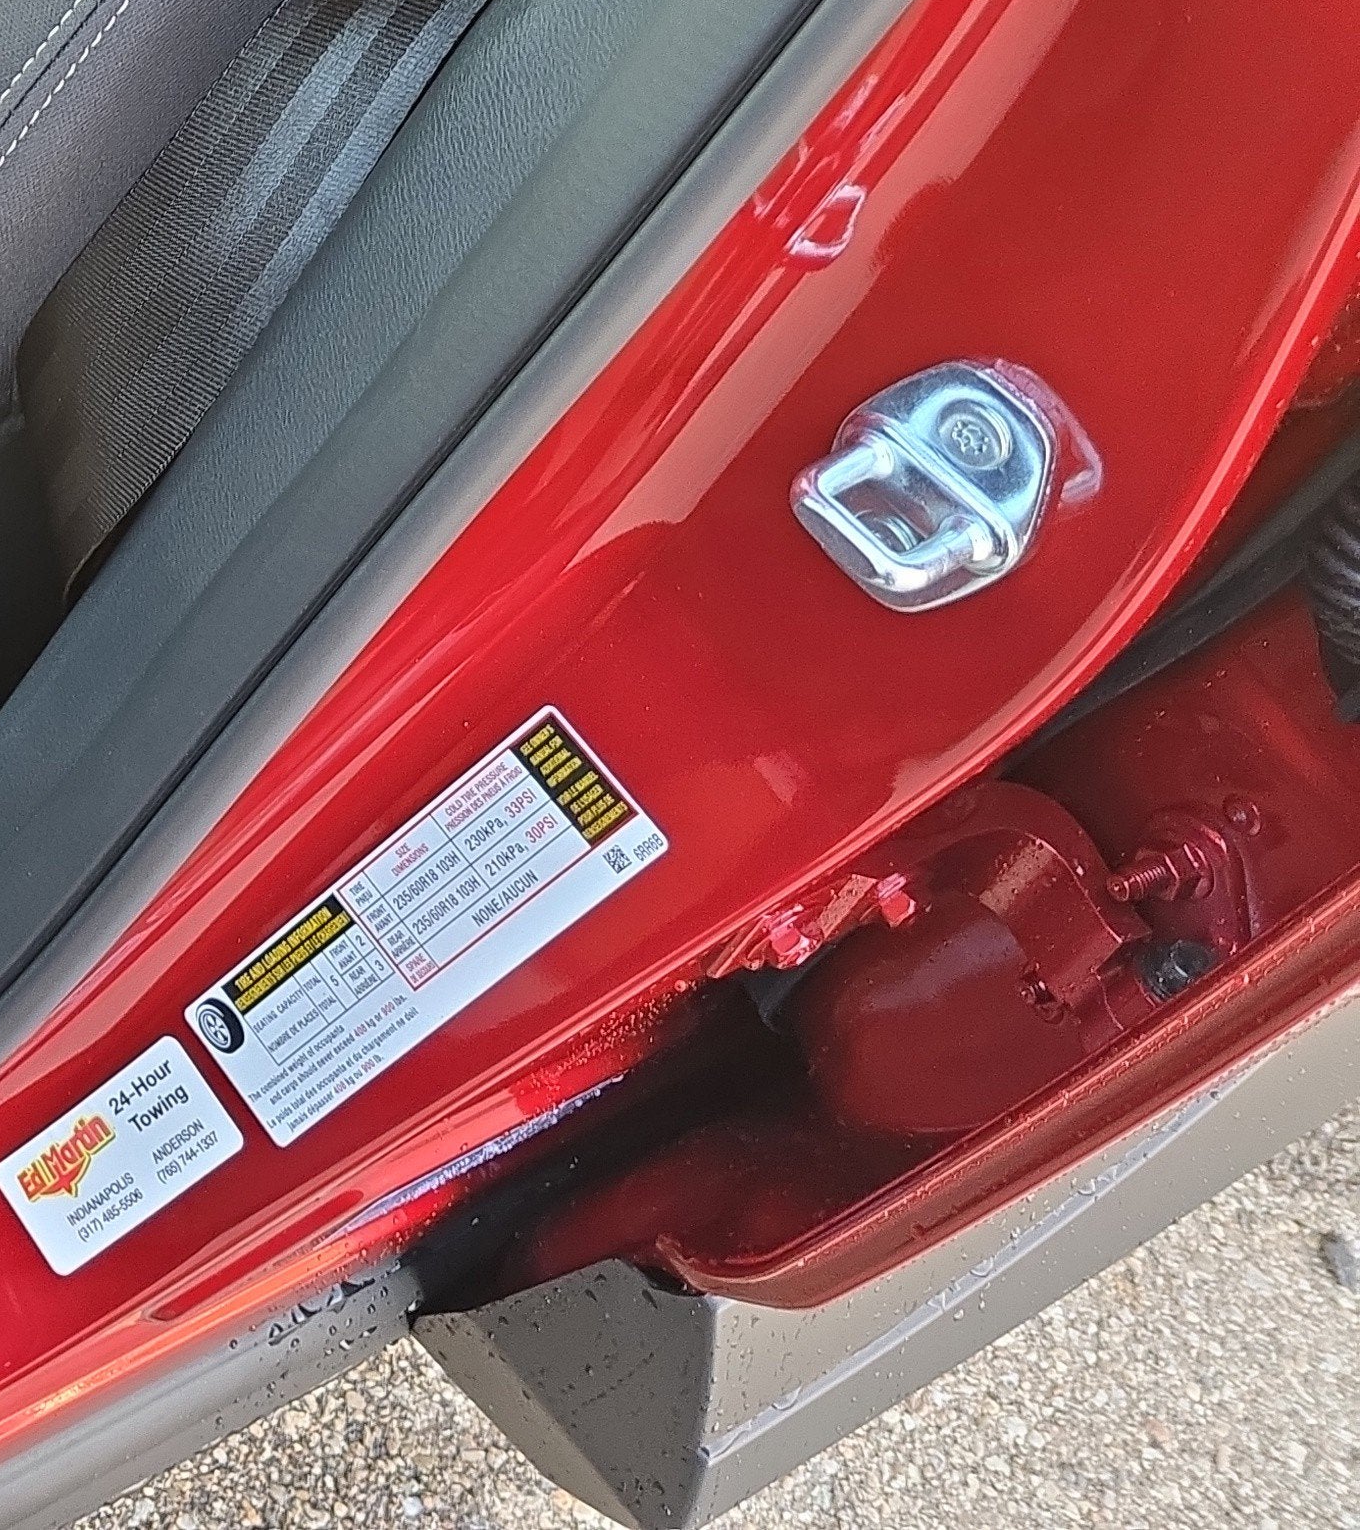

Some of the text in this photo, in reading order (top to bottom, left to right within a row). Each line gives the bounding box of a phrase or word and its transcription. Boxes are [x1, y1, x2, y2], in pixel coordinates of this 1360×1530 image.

[443, 761, 508, 817] COLD TIRE PRESSURE
[444, 806, 474, 833] PRESSION
[469, 796, 485, 812] DES
[462, 787, 538, 854] 230kPa, 33PSI
[390, 842, 429, 877] DIMENSIONS
[393, 841, 411, 859] SIZE
[482, 812, 559, 878] 210kPa, 30PSI
[347, 879, 365, 897] TIRE
[392, 849, 461, 911] 235/60R18 103H
[355, 889, 374, 907] PNEU
[366, 903, 387, 924] FRONT
[412, 874, 482, 936] 235/60R18 103H
[471, 869, 539, 928] NONE/AUCUN
[374, 912, 394, 933] AVANT
[386, 929, 405, 946] REAR
[328, 939, 349, 959] FRONT
[354, 934, 366, 947] 2
[234, 972, 253, 992] TIRE
[247, 960, 266, 981] AND
[336, 949, 358, 970] AVANT
[373, 958, 385, 972] 3
[405, 952, 426, 972] SPARE
[302, 975, 321, 992] TOTAL
[328, 974, 340, 987] 5
[253, 988, 304, 1033] SEATING CAPACITY
[317, 993, 337, 1012] TOTAL
[288, 1023, 300, 1036] DE
[296, 1008, 320, 1029] PLACES
[268, 1090, 283, 1106] and
[280, 1078, 300, 1098] cargo
[316, 1050, 335, 1068] never
[332, 1032, 356, 1055] exceed
[364, 1016, 377, 1030] kg
[373, 1011, 383, 1022] or
[303, 1085, 318, 1100] des
[402, 1005, 418, 1021] doit
[108, 1059, 172, 1116] 24-Hour
[247, 1089, 262, 1104] The
[260, 1067, 289, 1095] combined
[285, 1051, 310, 1075] weight
[305, 1046, 316, 1058] of
[343, 1074, 356, 1087] kg
[127, 1085, 189, 1132] Towing
[17, 1116, 112, 1199] Ed Martin
[152, 1118, 205, 1165] ANDERSON
[156, 1130, 219, 1184] (765) 744-1337
[66, 1172, 134, 1227] INDIANAPOLIS
[76, 1215, 105, 1244] (317)
